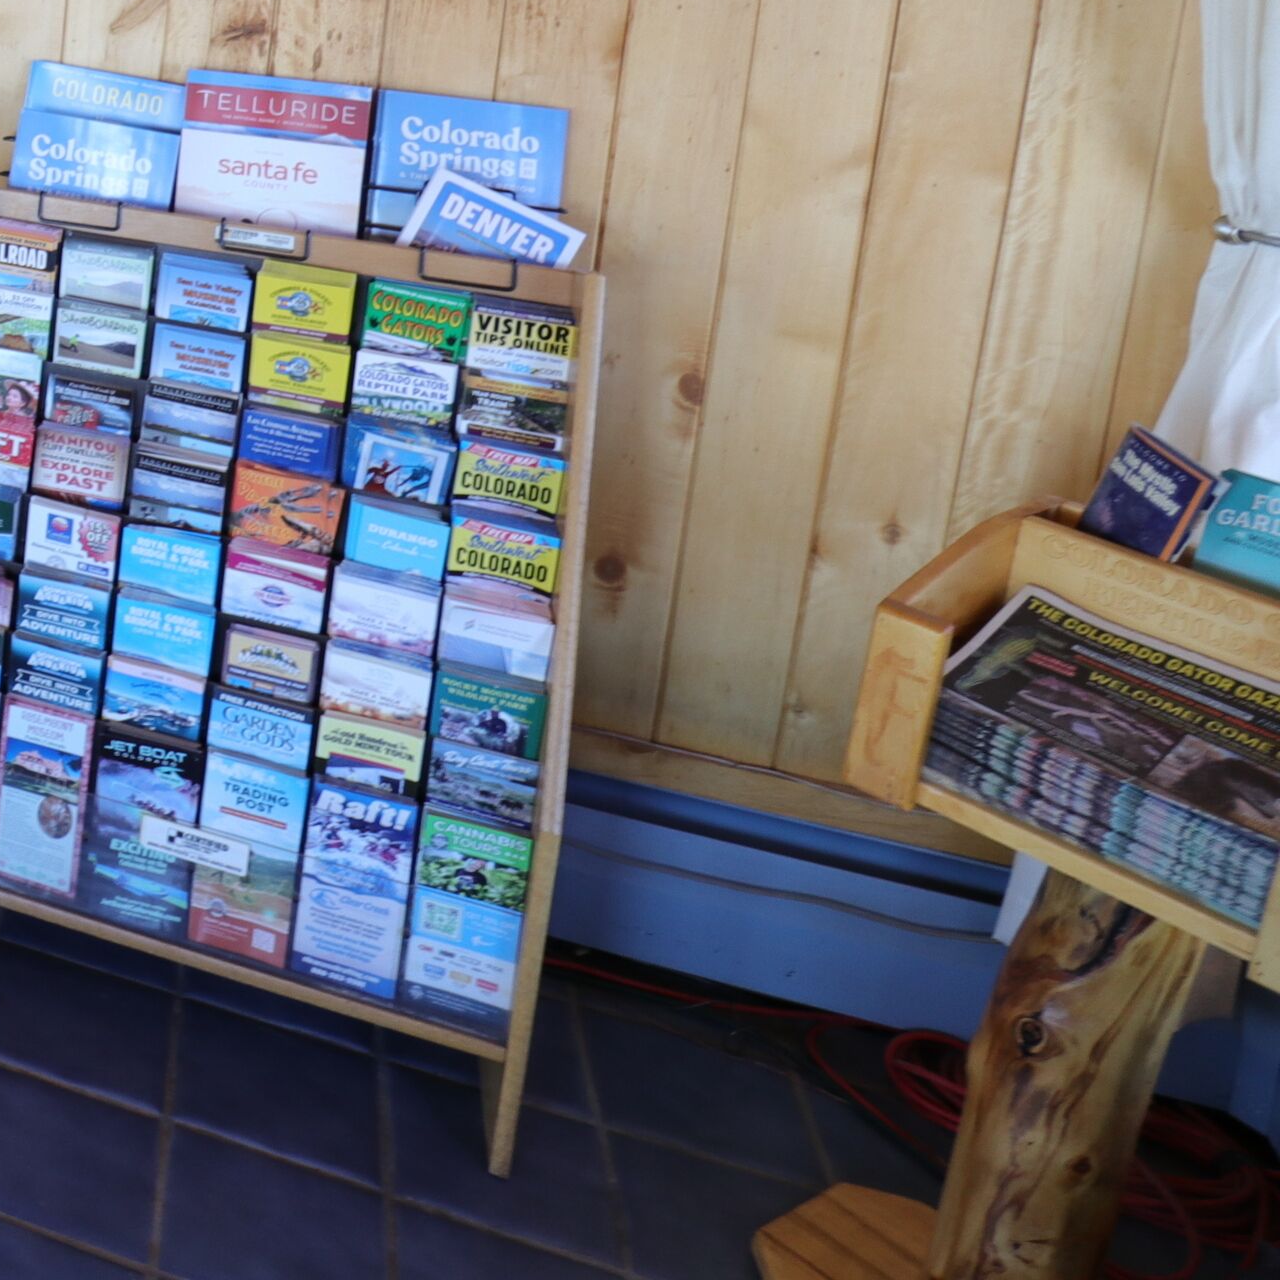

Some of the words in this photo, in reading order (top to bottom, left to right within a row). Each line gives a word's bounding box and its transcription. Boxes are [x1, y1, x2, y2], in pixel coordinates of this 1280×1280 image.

[52, 77, 163, 116] COLORADO
[196, 89, 357, 126] TELLURIDE
[401, 115, 540, 154] Colorado
[31, 133, 153, 175] Colorado
[400, 141, 516, 179] Springs
[28, 157, 129, 197] Springs
[218, 158, 287, 181] santa
[292, 162, 318, 184] fe
[243, 179, 288, 192] COUNTY
[440, 192, 554, 264] DENVER
[372, 290, 464, 328] COLORADO
[381, 315, 446, 345] GATORS
[477, 314, 570, 343] VISITOR
[474, 332, 506, 347] TIPS
[512, 337, 569, 356] ONLINE
[357, 379, 409, 395] REPTILE
[412, 388, 448, 401] PARK
[359, 370, 411, 386] COLORADO
[413, 377, 449, 392] GATORS
[41, 432, 117, 453] MANITOU
[42, 441, 64, 454] CLIFF
[66, 445, 116, 462] DWELLINGS
[41, 460, 114, 481] EXPLORE
[56, 473, 107, 492] PAST
[462, 471, 552, 504] COLORADO
[367, 523, 438, 549] DURANGO
[480, 526, 506, 540] FREE
[507, 531, 533, 544] MAP
[456, 547, 548, 582] COLORADO
[19, 618, 100, 644] ADVENTURE
[36, 610, 58, 620] DIVE
[62, 616, 86, 627] INTO
[1027, 598, 1062, 623] THE
[1063, 618, 1166, 665] COLORADO
[1165, 655, 1237, 692] GATOR
[12, 683, 92, 711] ADVENTURE
[442, 677, 477, 693] ROCKY
[480, 685, 536, 704] MOUNTAIN
[447, 687, 496, 702] WILDLIFE
[498, 697, 528, 711] PARK
[219, 693, 244, 707] FREE
[245, 700, 305, 721] ATTRACTION
[1088, 672, 1203, 725] WELCOME!
[1204, 720, 1275, 754] COME
[222, 706, 298, 739] GARDEN
[104, 740, 137, 752] JET
[140, 744, 188, 762] BOAT
[241, 726, 294, 753] GODS
[114, 751, 178, 767] COLORADO
[224, 781, 289, 808] TRADING
[236, 795, 274, 813] POST
[316, 790, 412, 831] Raft!
[433, 820, 527, 852] CANNABIS
[452, 837, 502, 856] TOURS
